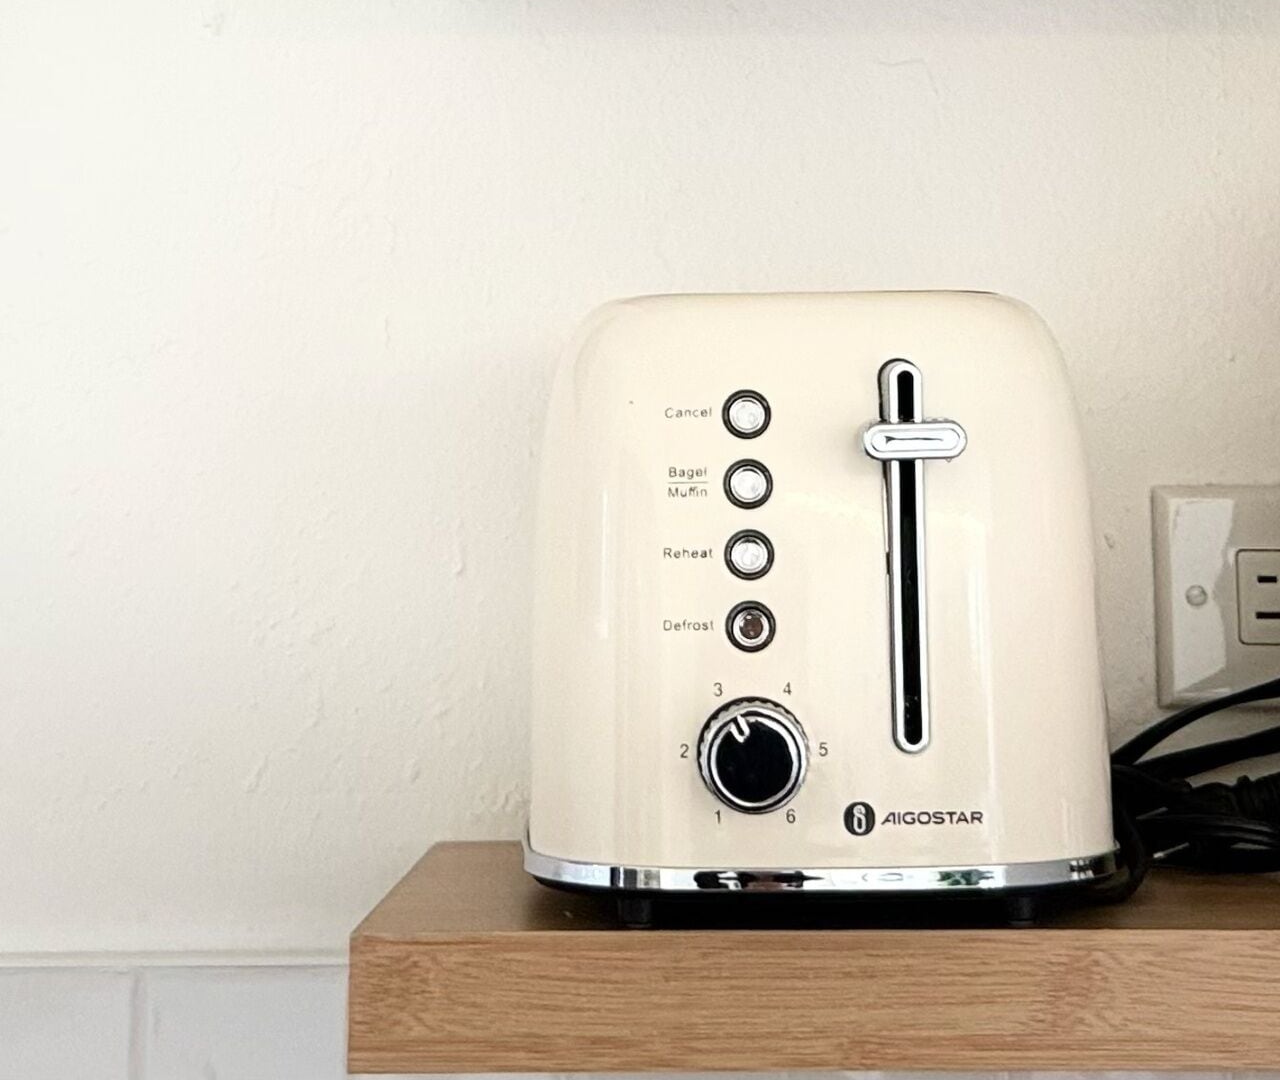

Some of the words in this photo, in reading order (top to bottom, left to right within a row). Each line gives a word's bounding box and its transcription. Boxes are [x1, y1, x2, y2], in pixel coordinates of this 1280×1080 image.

[664, 406, 713, 419] Cancel
[668, 466, 707, 480] Bagel
[667, 486, 708, 498] Muffin
[663, 546, 713, 559] Reheat
[663, 618, 715, 631] Defrost
[713, 682, 723, 697] 3
[783, 682, 792, 695] 4
[680, 744, 689, 759] 2
[819, 742, 828, 757] 5
[714, 809, 721, 824] 1
[786, 808, 796, 824] 6
[881, 811, 984, 825] AIGOSTAR
